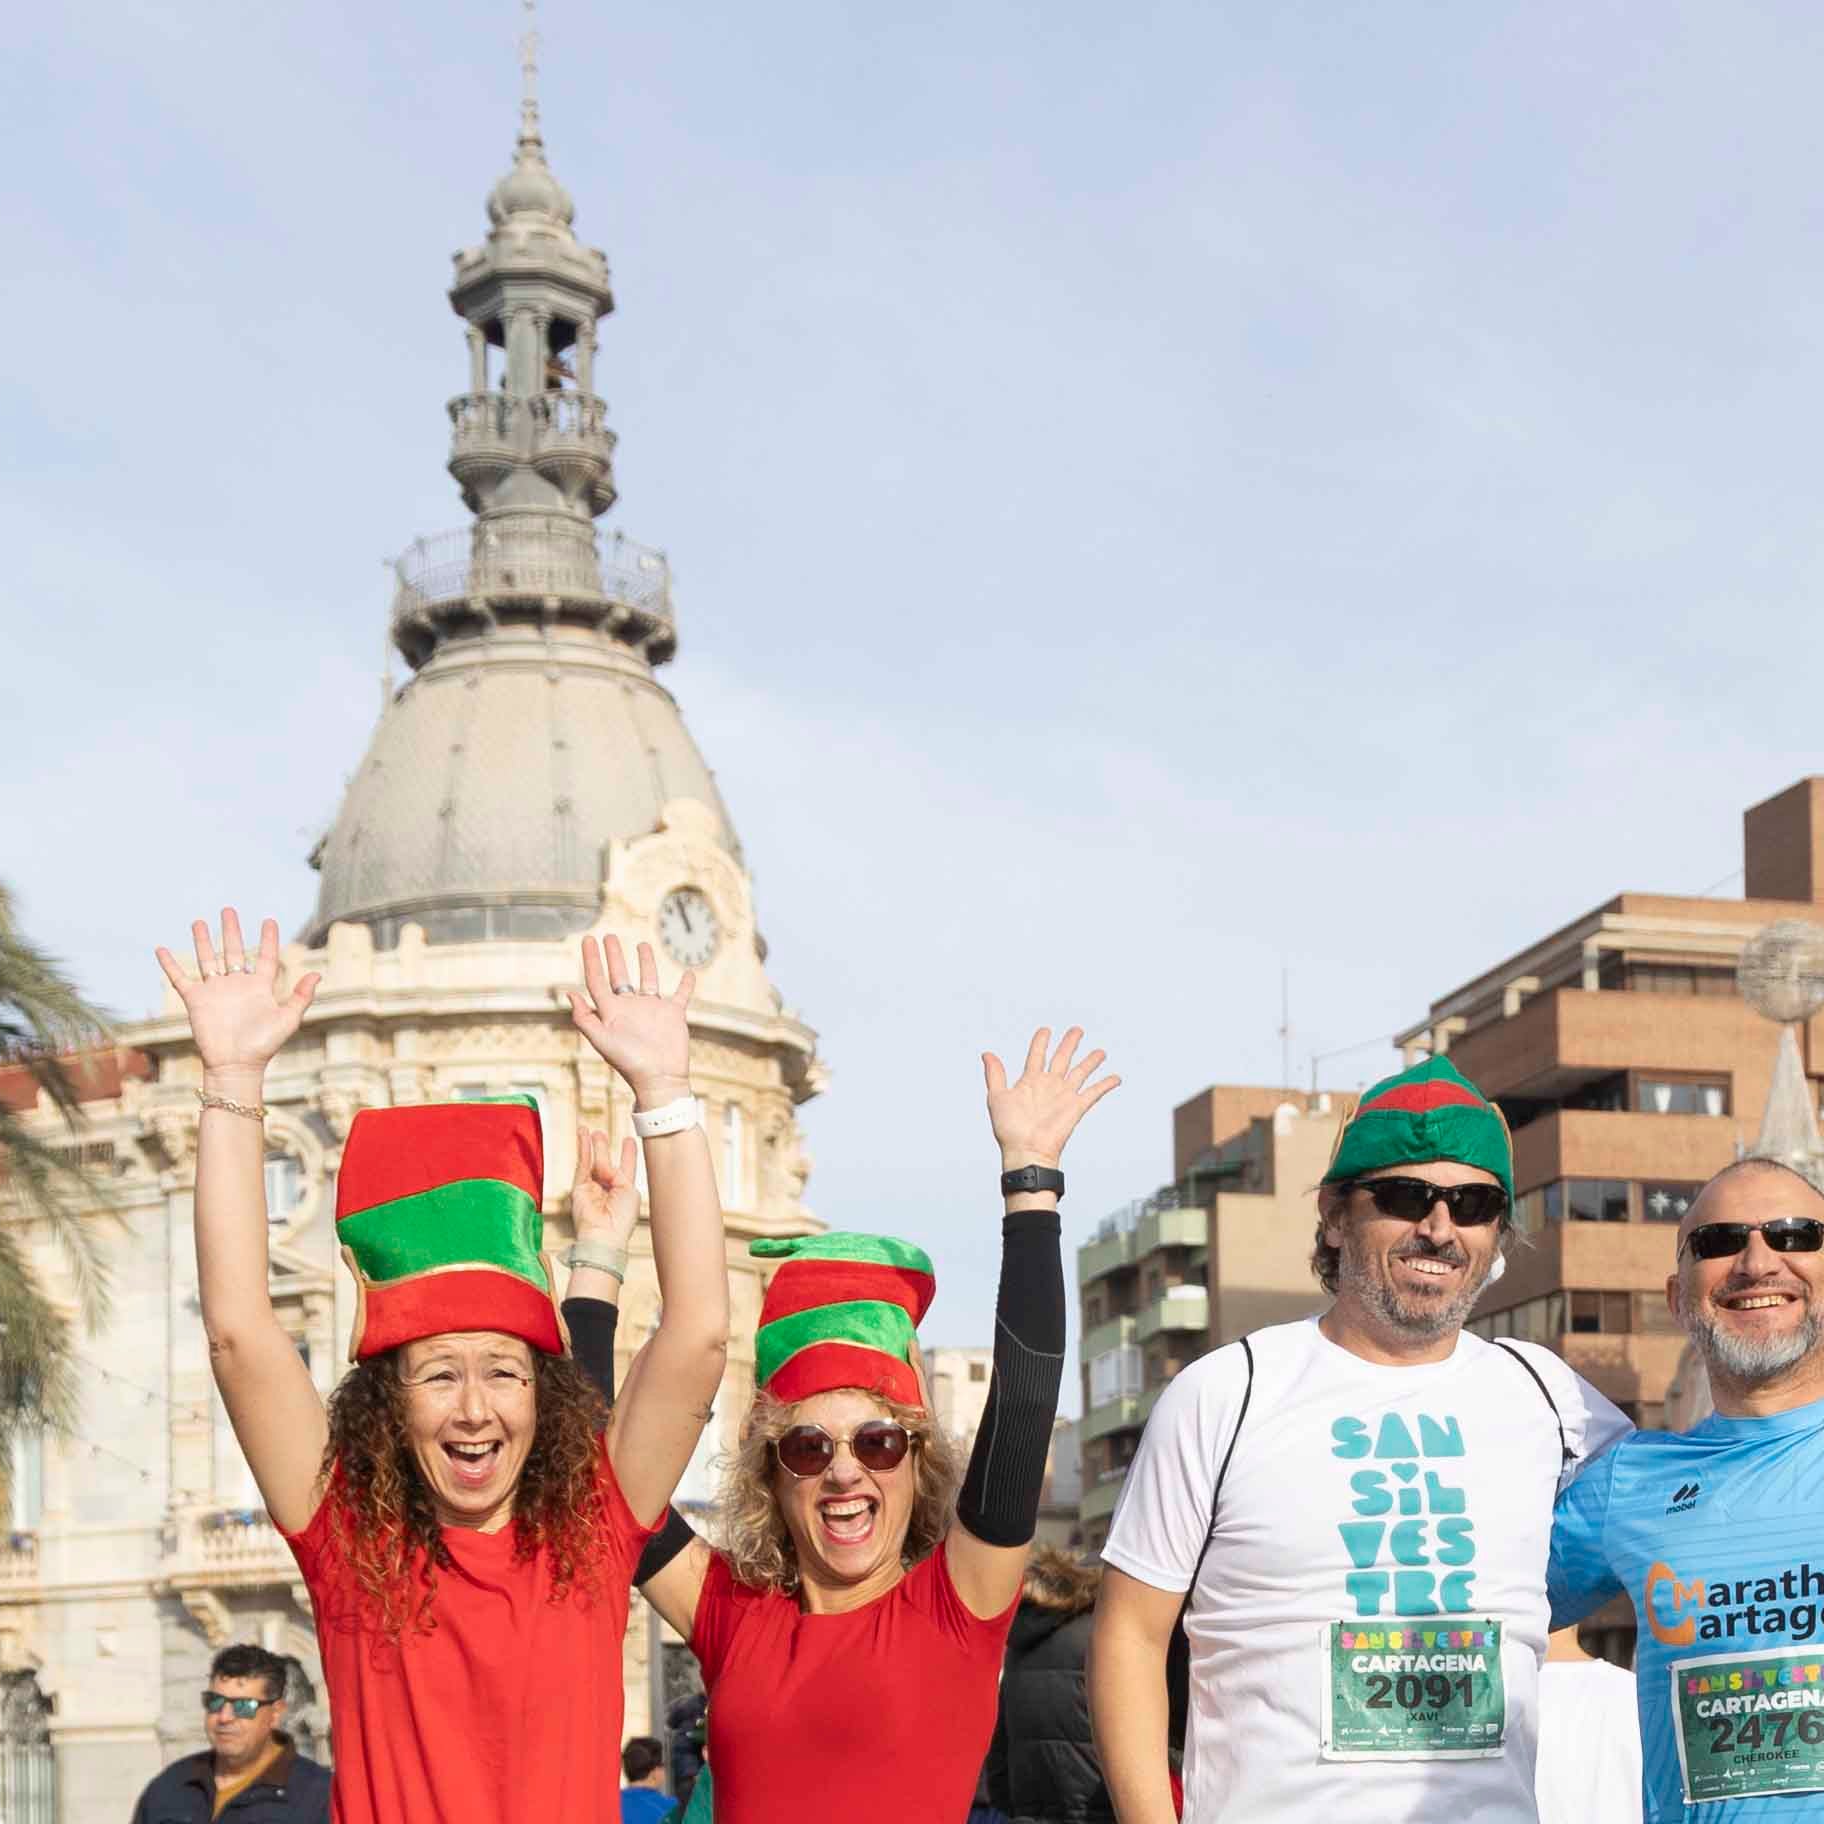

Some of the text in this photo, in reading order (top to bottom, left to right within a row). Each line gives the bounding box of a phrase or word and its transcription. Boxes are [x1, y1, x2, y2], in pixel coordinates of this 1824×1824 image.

[1331, 1412, 1466, 1459] SAN
[1337, 1517, 1476, 1569] VES
[1345, 1571, 1477, 1616] TRE
[1341, 1631, 1385, 1649] SAN
[1351, 1654, 1488, 1673] CARTAGENA
[1365, 1674, 1473, 1709] 2091
[1687, 1672, 1726, 1696] SAN
[1410, 1711, 1438, 1721] XAVI
[1733, 1750, 1801, 1765] CHEROKEE
